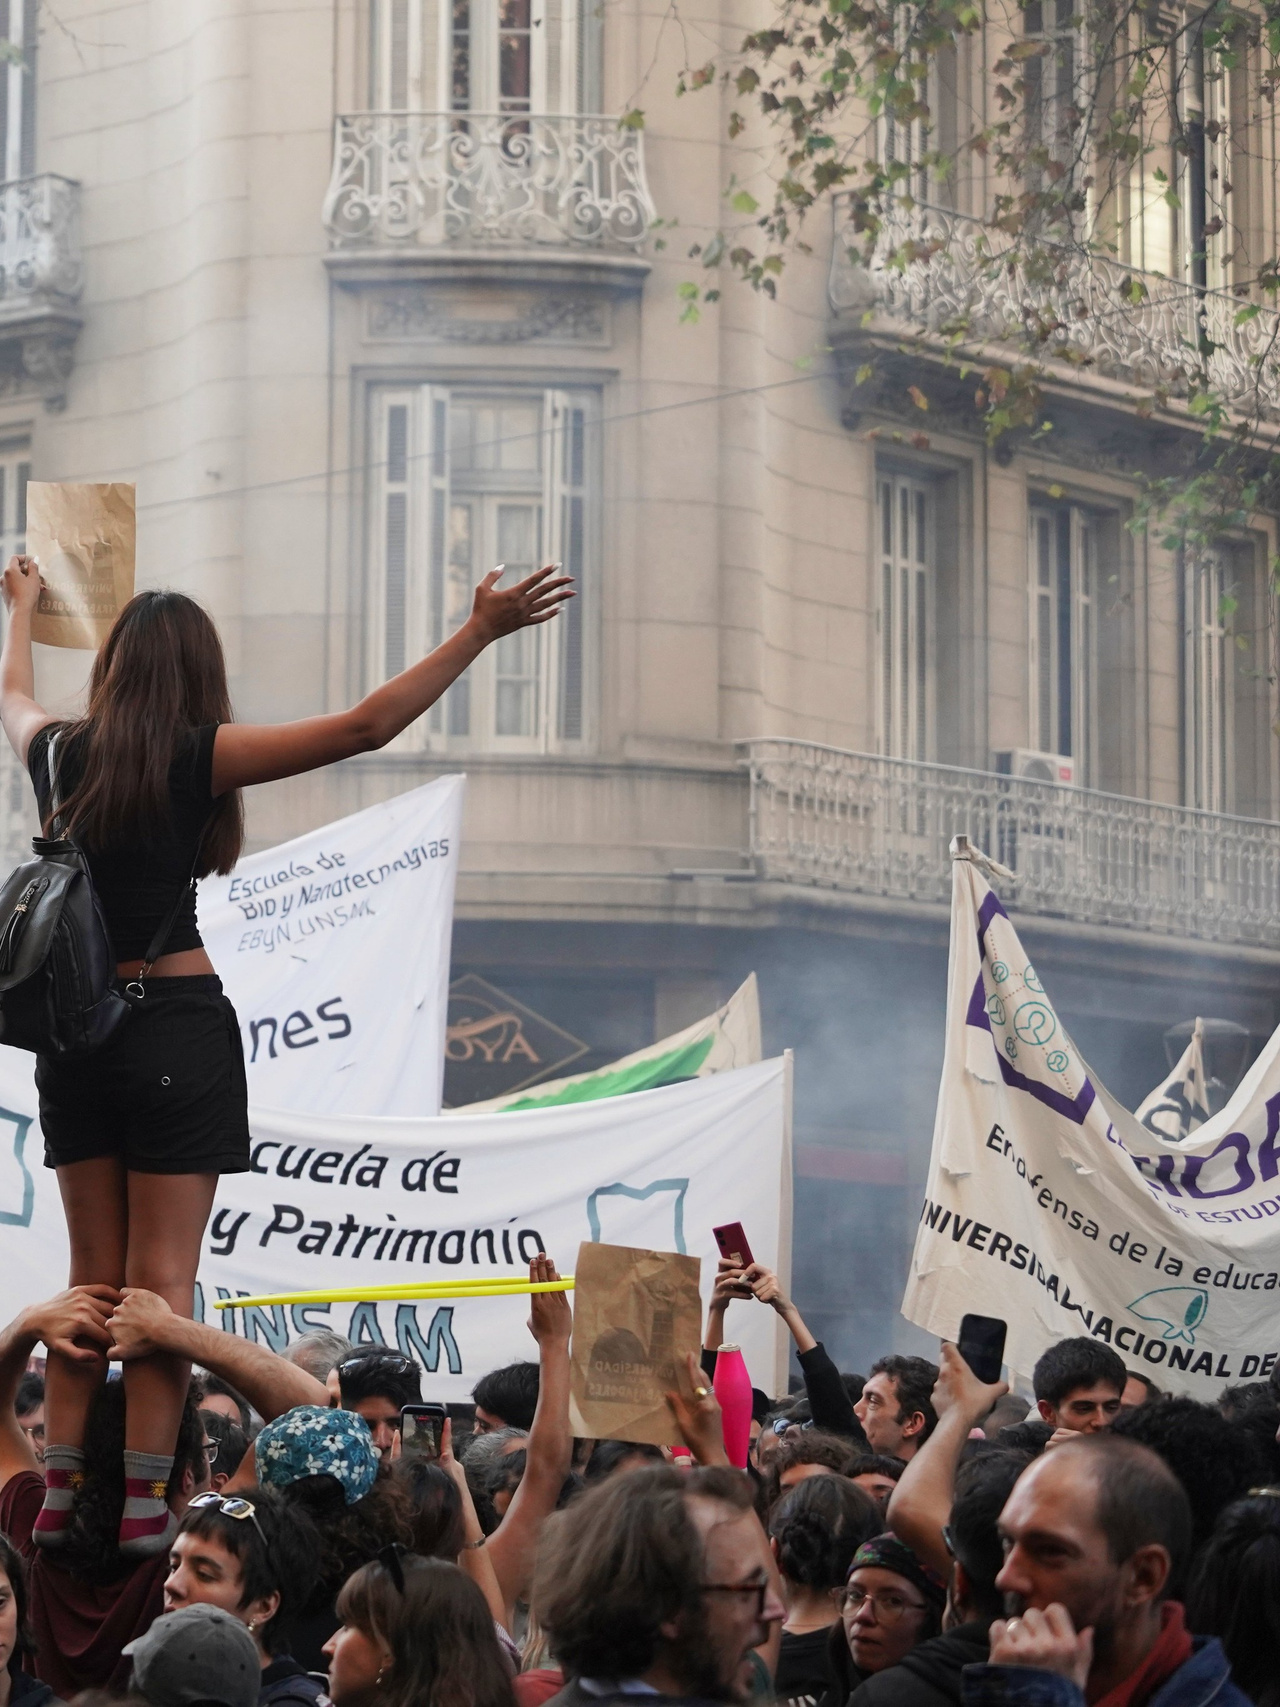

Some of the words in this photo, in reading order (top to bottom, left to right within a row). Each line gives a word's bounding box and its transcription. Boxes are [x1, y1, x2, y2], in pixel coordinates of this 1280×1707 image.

[228, 860, 315, 902] Escuela
[316, 851, 346, 870] de
[281, 894, 294, 919] y
[241, 996, 352, 1063] nes
[249, 1138, 389, 1188] cuela
[401, 1150, 461, 1194] de
[210, 1208, 251, 1256] y
[259, 1203, 547, 1265] Patrimonio
[1016, 1156, 1100, 1241] dfensa
[1109, 1231, 1148, 1264] de
[1154, 1246, 1184, 1277] la
[1193, 1263, 1280, 1290] educa
[1195, 1194, 1280, 1224] ESTUD
[920, 1198, 1079, 1311] NIVERSIDA
[1239, 1352, 1278, 1378] DE
